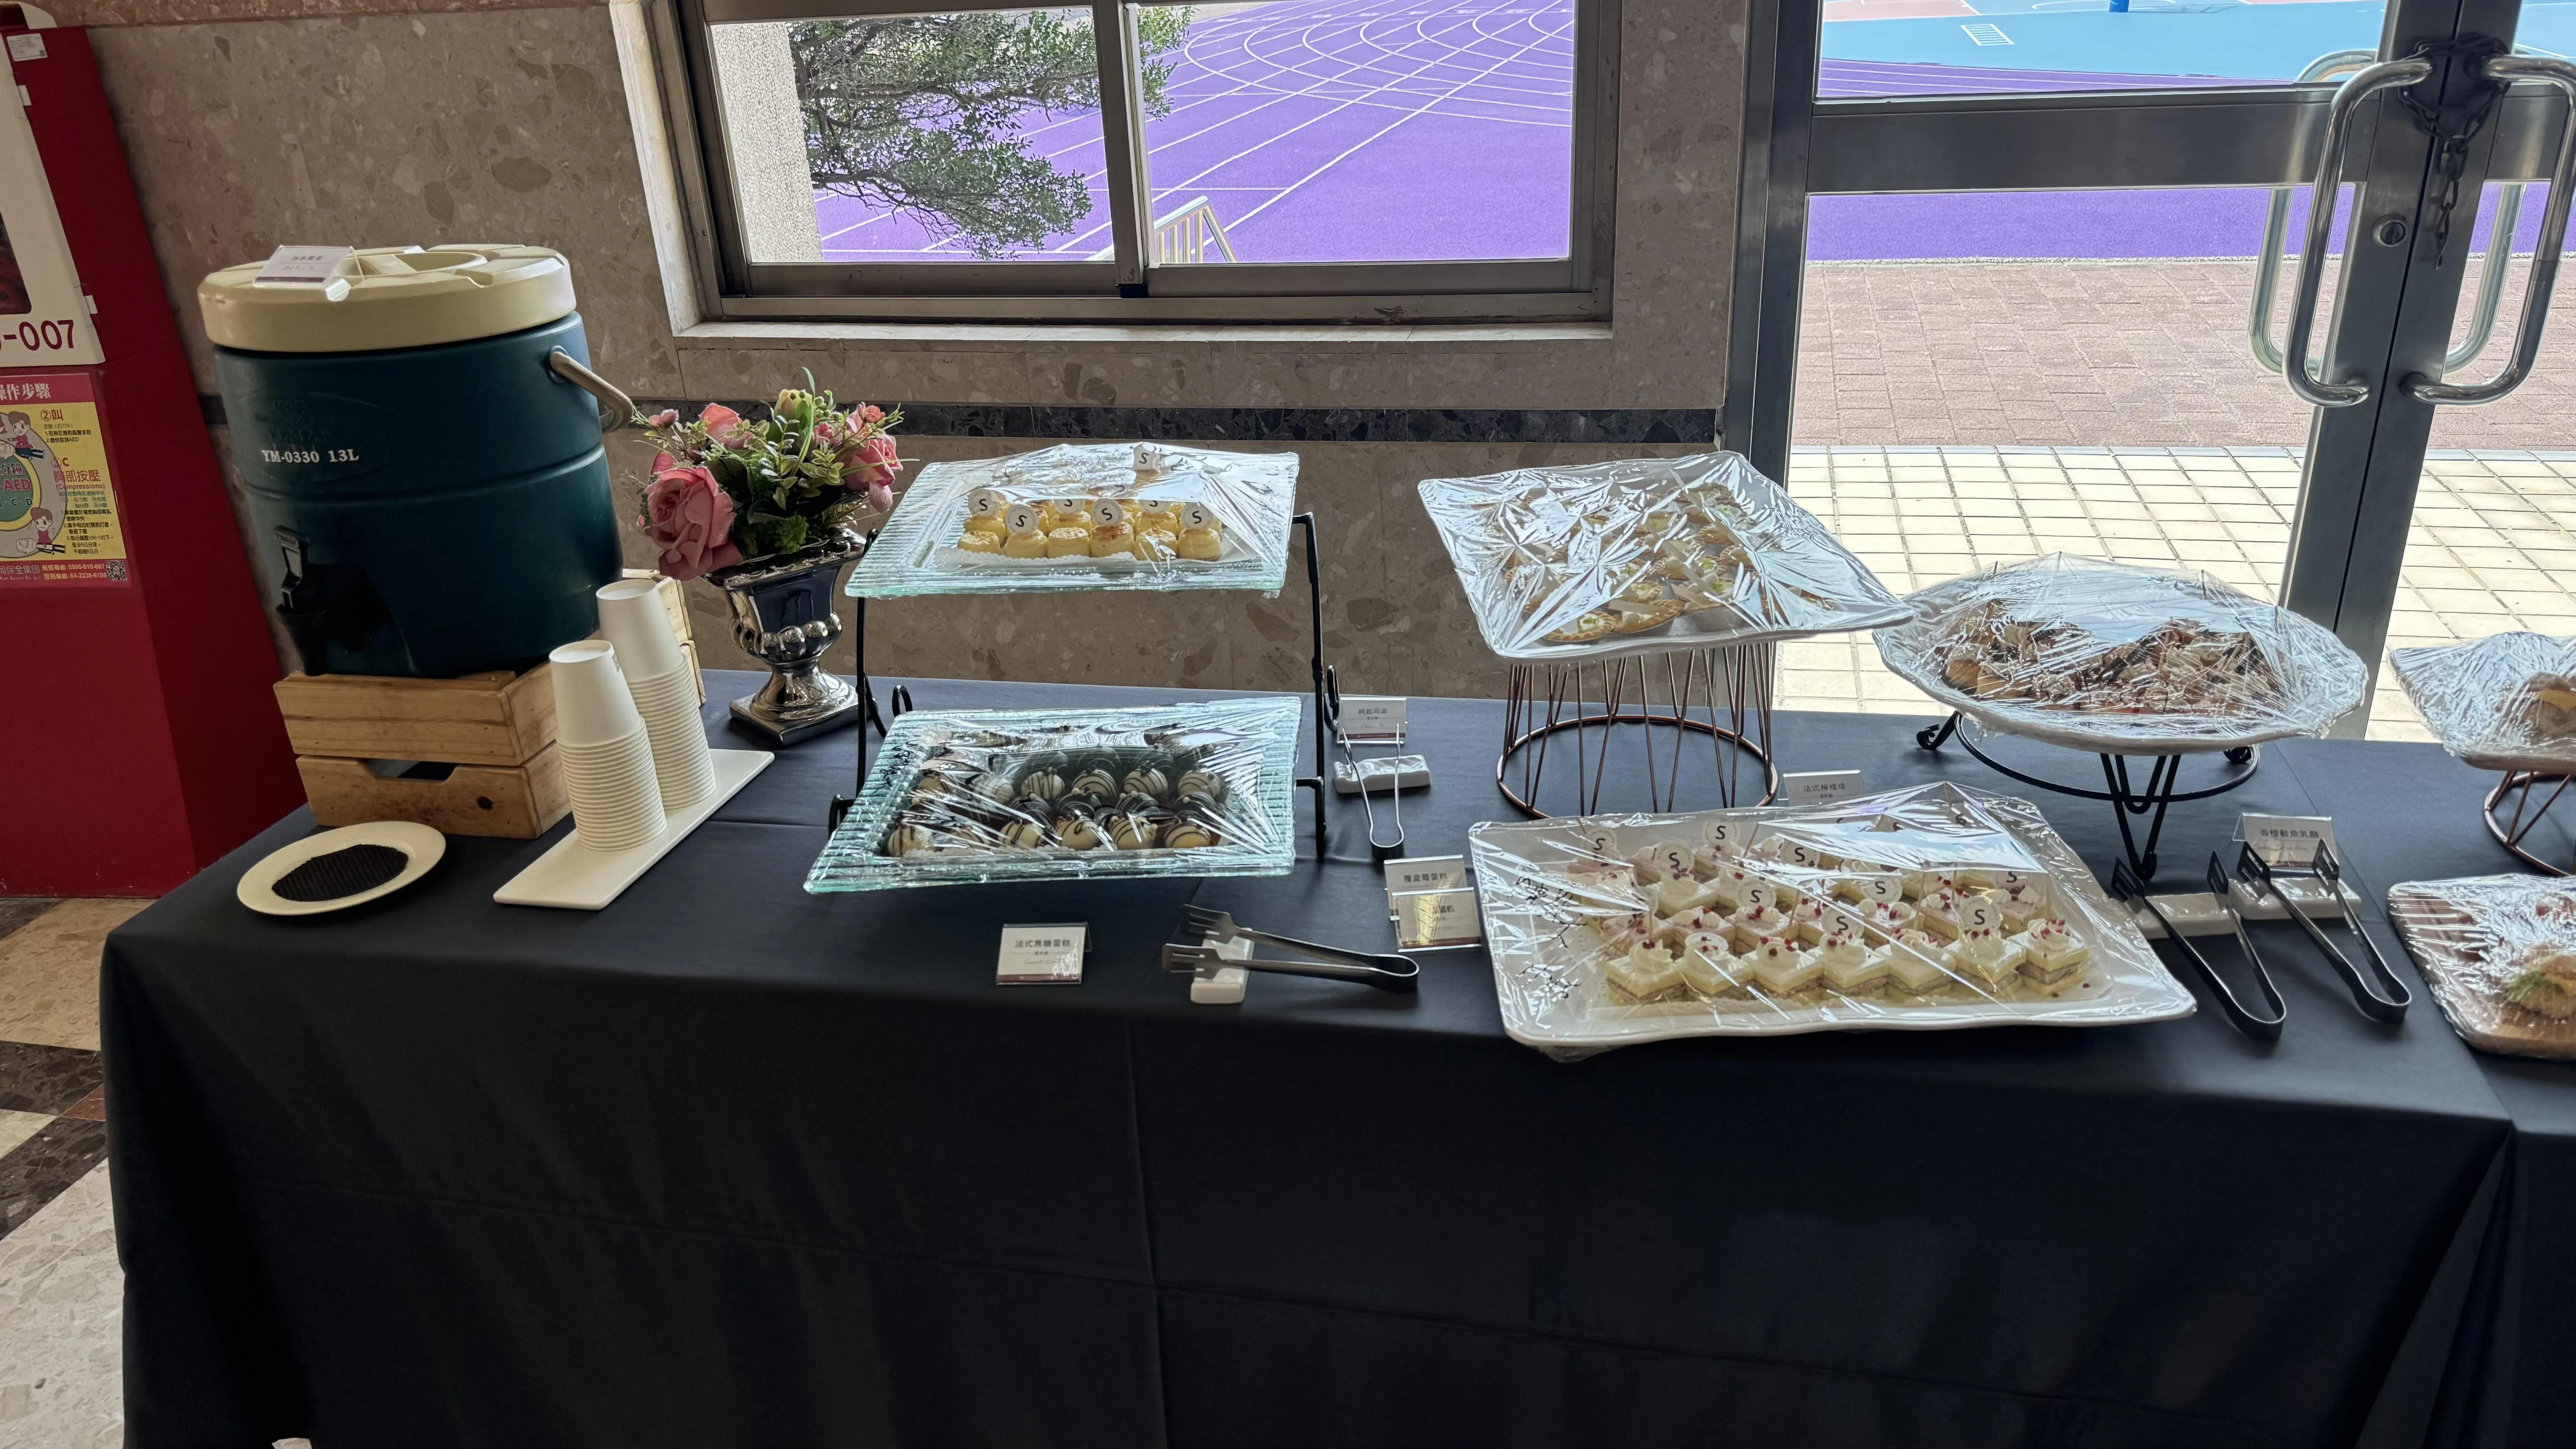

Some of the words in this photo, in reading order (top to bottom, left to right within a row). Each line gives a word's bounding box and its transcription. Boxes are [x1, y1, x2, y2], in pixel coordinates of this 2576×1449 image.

[0, 320, 74, 350] -007
[261, 450, 320, 463] YM-0330
[328, 449, 360, 462] 13L
[1139, 452, 1149, 464] S
[979, 499, 988, 511] S
[1015, 515, 1027, 527] S
[1102, 508, 1113, 521] S
[1192, 511, 1202, 524] S
[1716, 825, 1726, 839] S
[1594, 838, 1605, 851] S
[1669, 852, 1680, 868] S
[1795, 847, 1806, 862] S
[1875, 881, 1886, 895] S
[1750, 890, 1762, 903] S
[1836, 916, 1849, 931] S
[1974, 909, 1986, 925] S
[1015, 939, 1071, 948] 法式焦糖蛋糕
